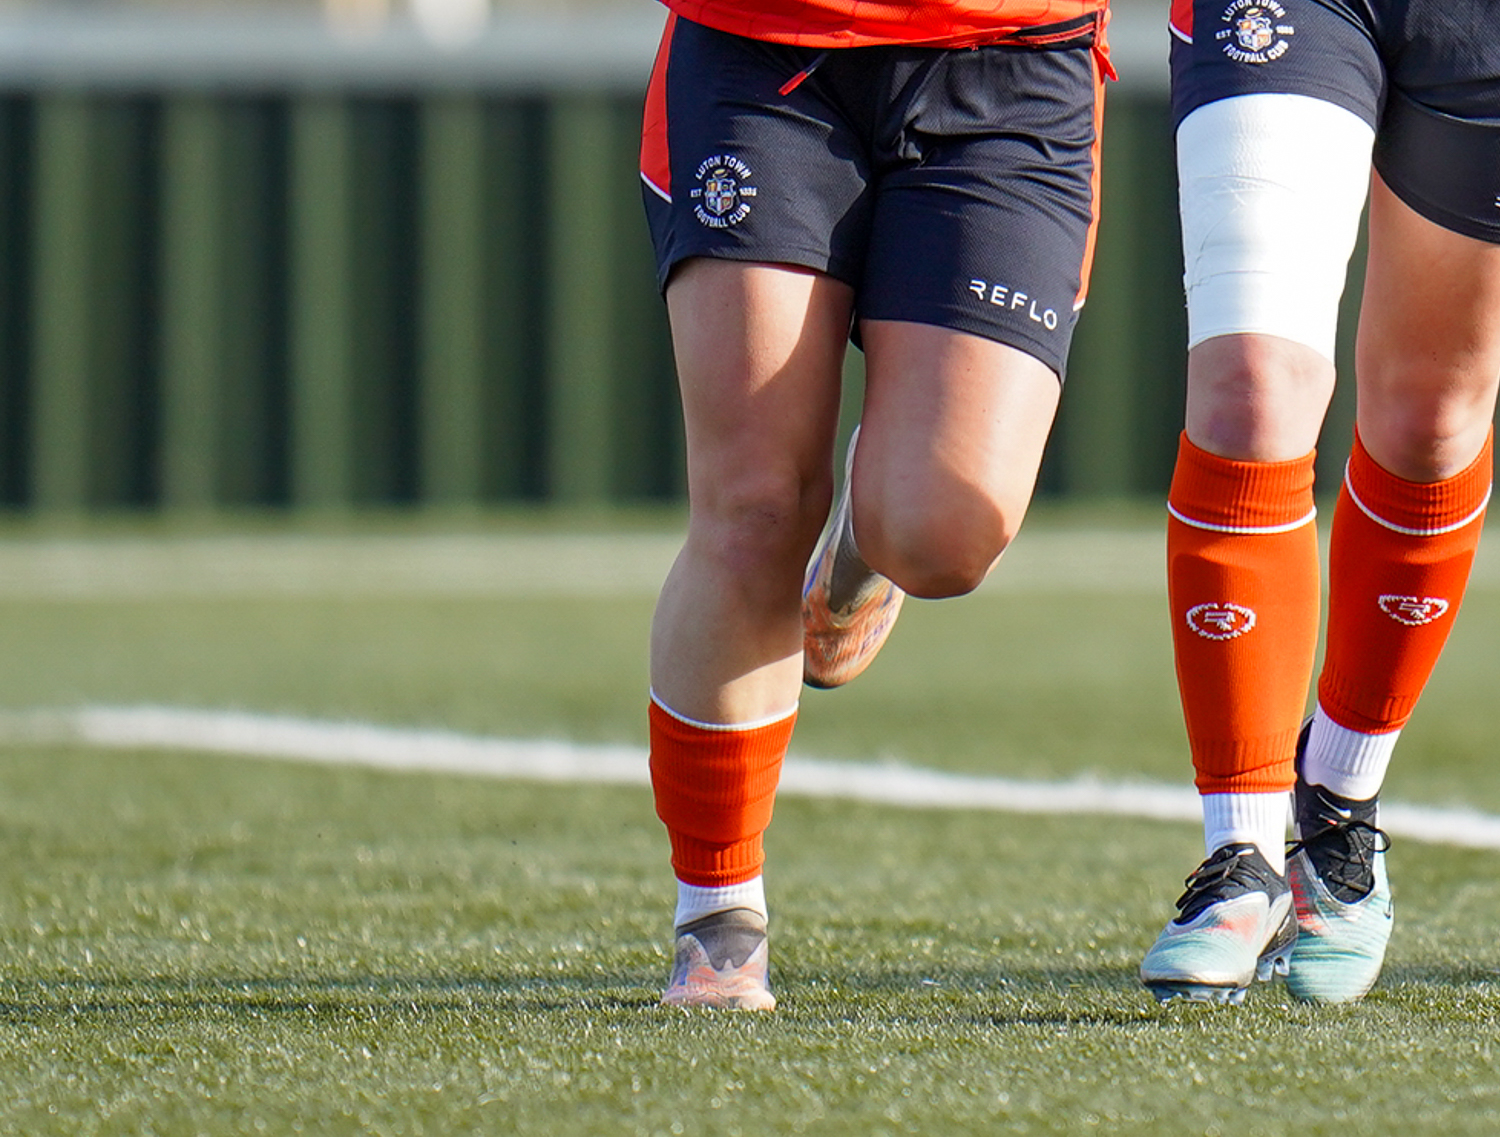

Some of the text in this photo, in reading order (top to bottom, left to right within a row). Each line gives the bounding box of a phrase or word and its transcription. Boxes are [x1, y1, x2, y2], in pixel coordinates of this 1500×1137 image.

[1222, 43, 1269, 63] FOOTBALL
[695, 154, 752, 180] LUTON TOWN
[969, 279, 1058, 331] REFLO
